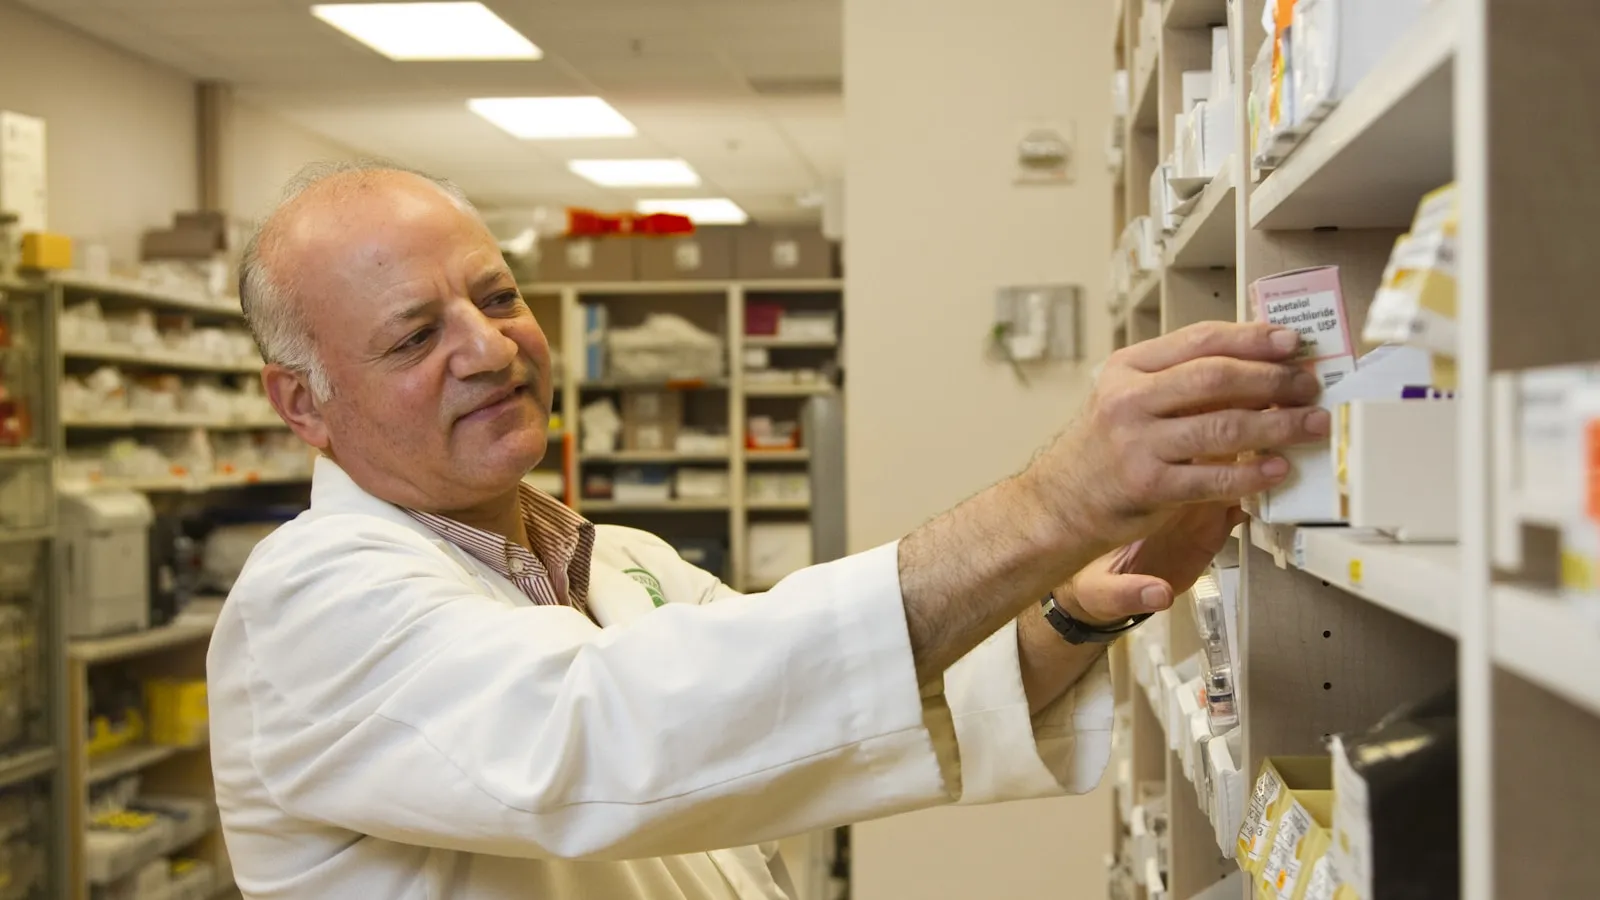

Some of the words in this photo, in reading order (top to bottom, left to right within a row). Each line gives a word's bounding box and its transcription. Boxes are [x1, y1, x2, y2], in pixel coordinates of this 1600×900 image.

[1267, 298, 1310, 314] Labetalol
[1270, 308, 1334, 325] Hydrochloride
[1317, 319, 1336, 332] USP
